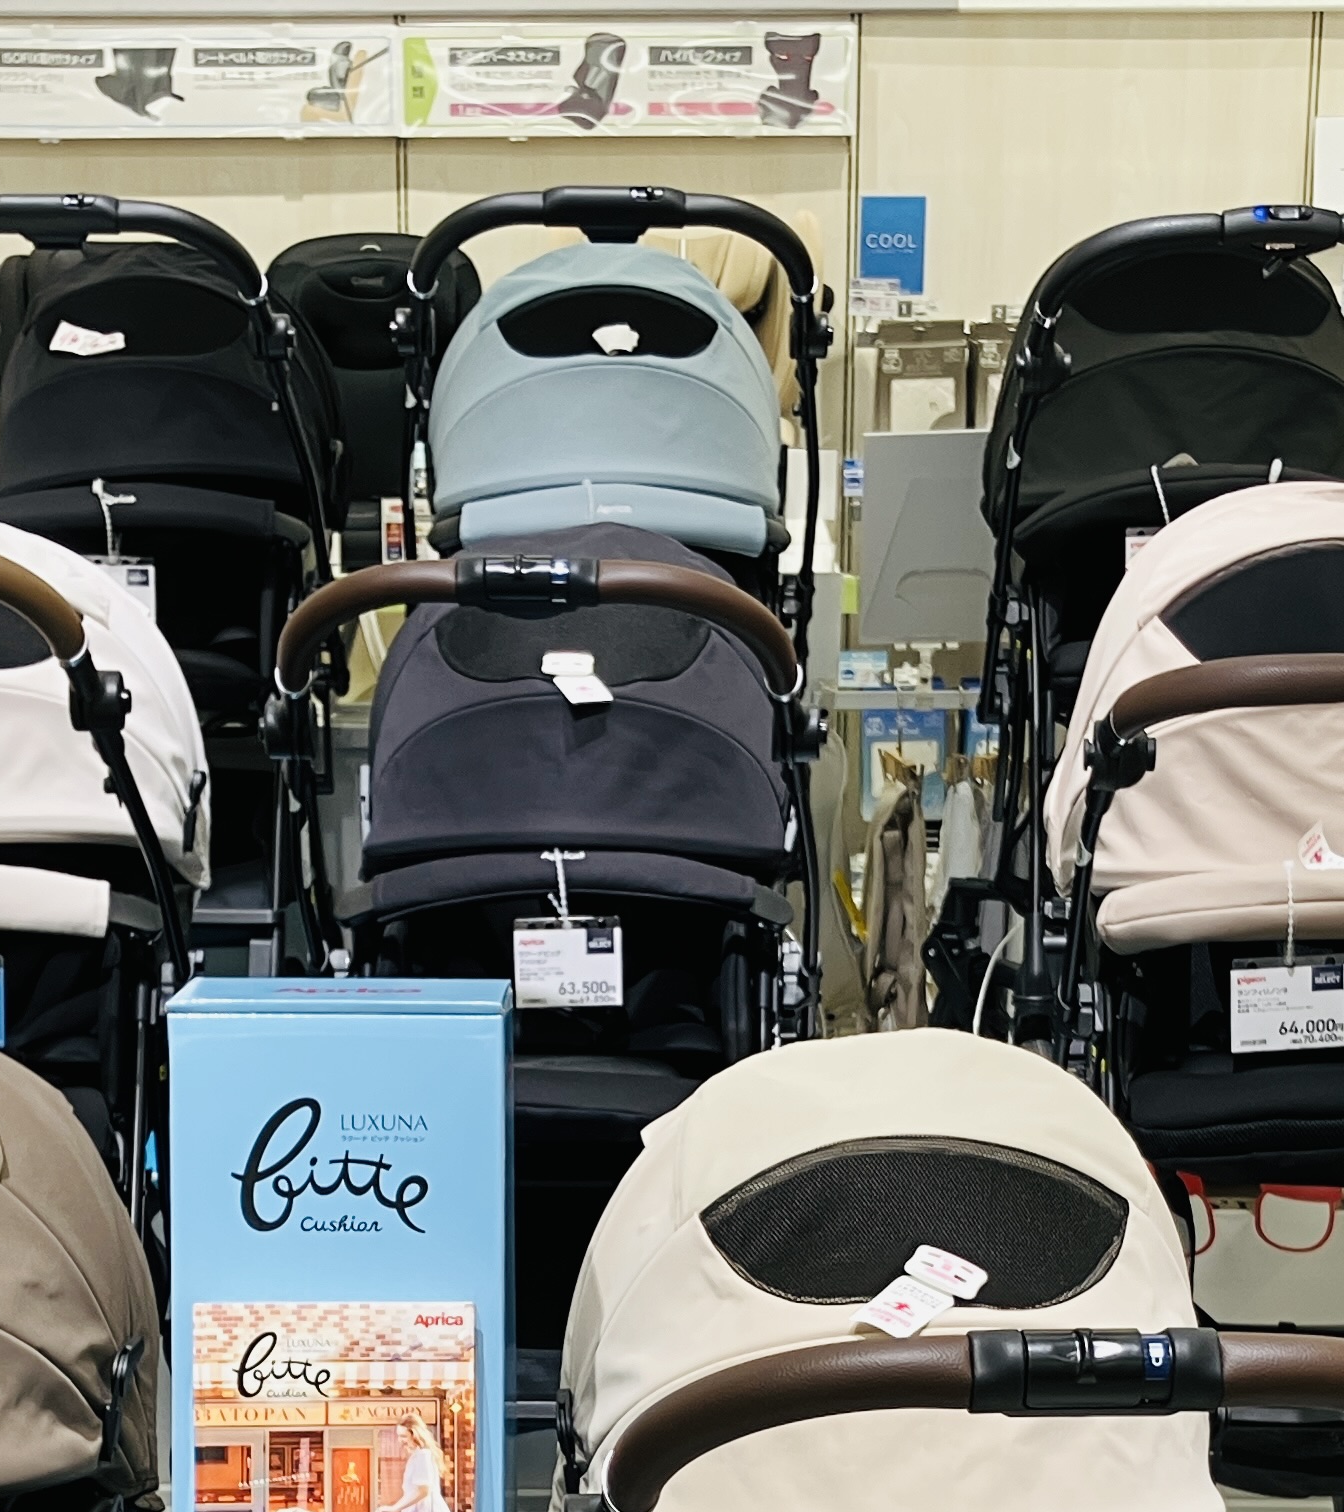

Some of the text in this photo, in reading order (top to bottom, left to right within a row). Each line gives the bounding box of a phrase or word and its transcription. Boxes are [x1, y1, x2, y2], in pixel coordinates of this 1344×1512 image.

[865, 233, 918, 249] COOL
[340, 1113, 428, 1132] LUXUNA
[300, 1214, 384, 1233] Cushion
[413, 1311, 464, 1328] Aprica
